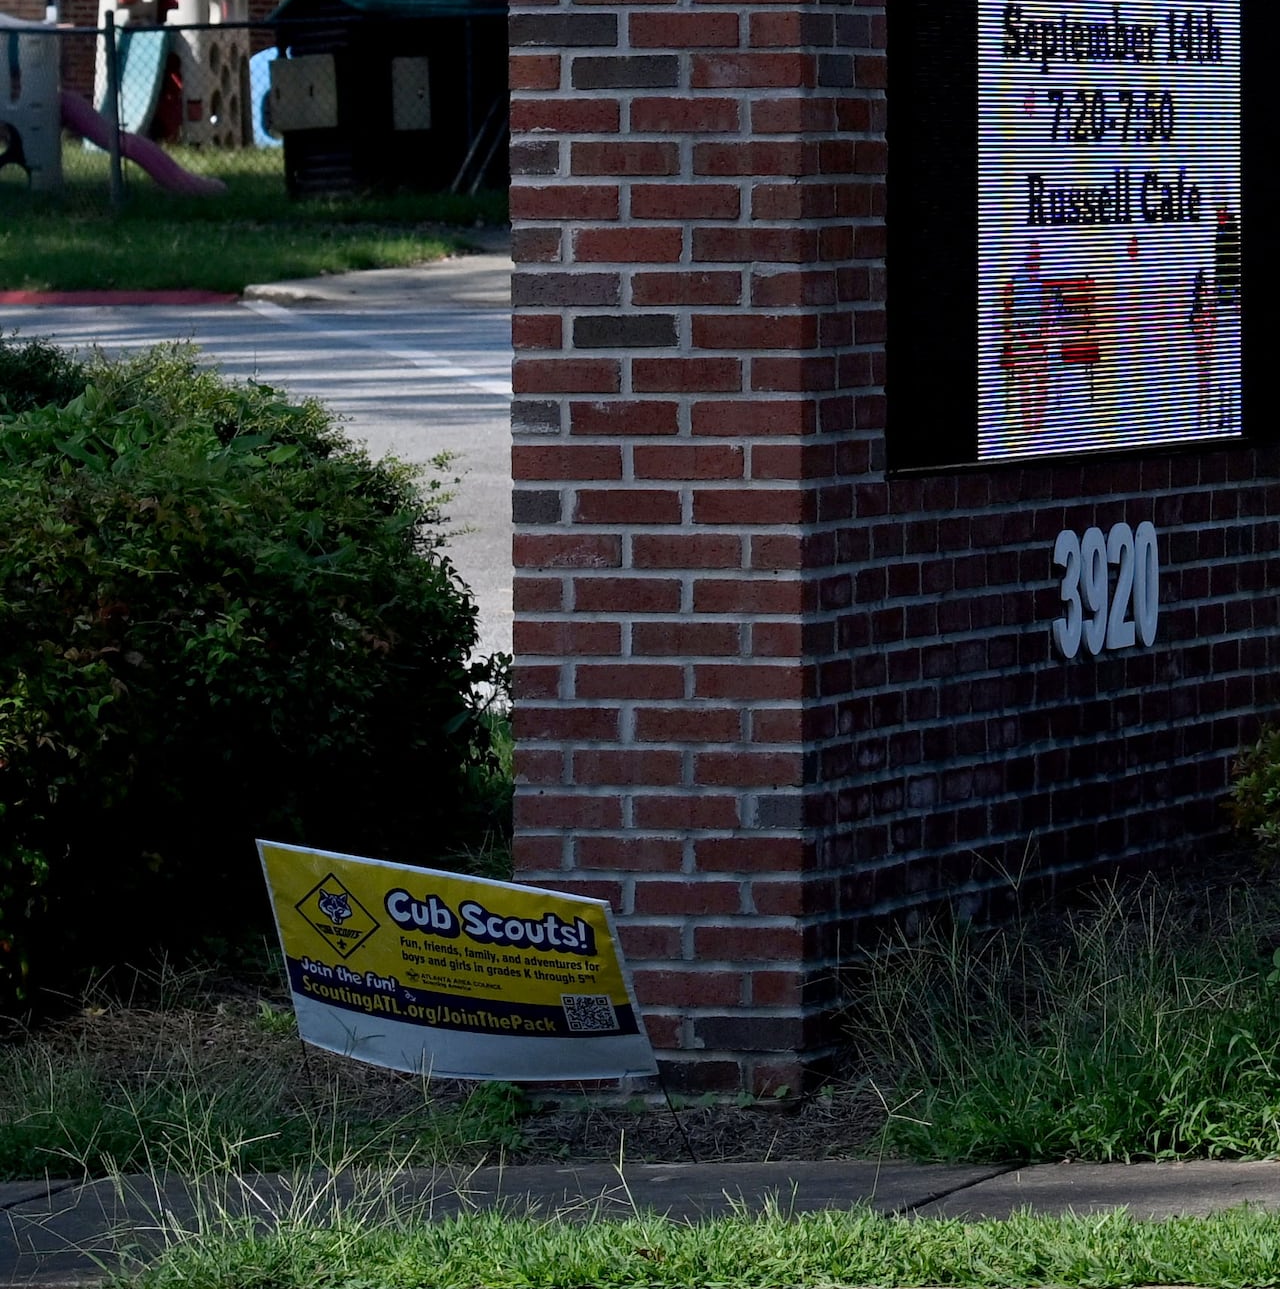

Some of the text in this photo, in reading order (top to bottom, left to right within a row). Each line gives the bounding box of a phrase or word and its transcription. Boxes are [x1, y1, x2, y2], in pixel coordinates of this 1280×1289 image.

[1002, 4, 1222, 74] September 14th
[1048, 89, 1175, 142] 7:20-7:50
[1027, 167, 1132, 225] Russell
[1053, 520, 1159, 659] 3920
[386, 891, 588, 949] Cub Scouts!
[301, 957, 333, 978] Join
[336, 966, 362, 985] the
[400, 936, 600, 972] Fun, friends, family, and adventures for
[401, 950, 425, 965] boys
[428, 957, 447, 967] and
[449, 959, 472, 971] girls
[474, 962, 484, 973] in
[486, 966, 521, 977] grades
[523, 968, 532, 979] K
[535, 970, 575, 985] through
[302, 974, 557, 1032] ScoutingATL.org/JoinThePack
